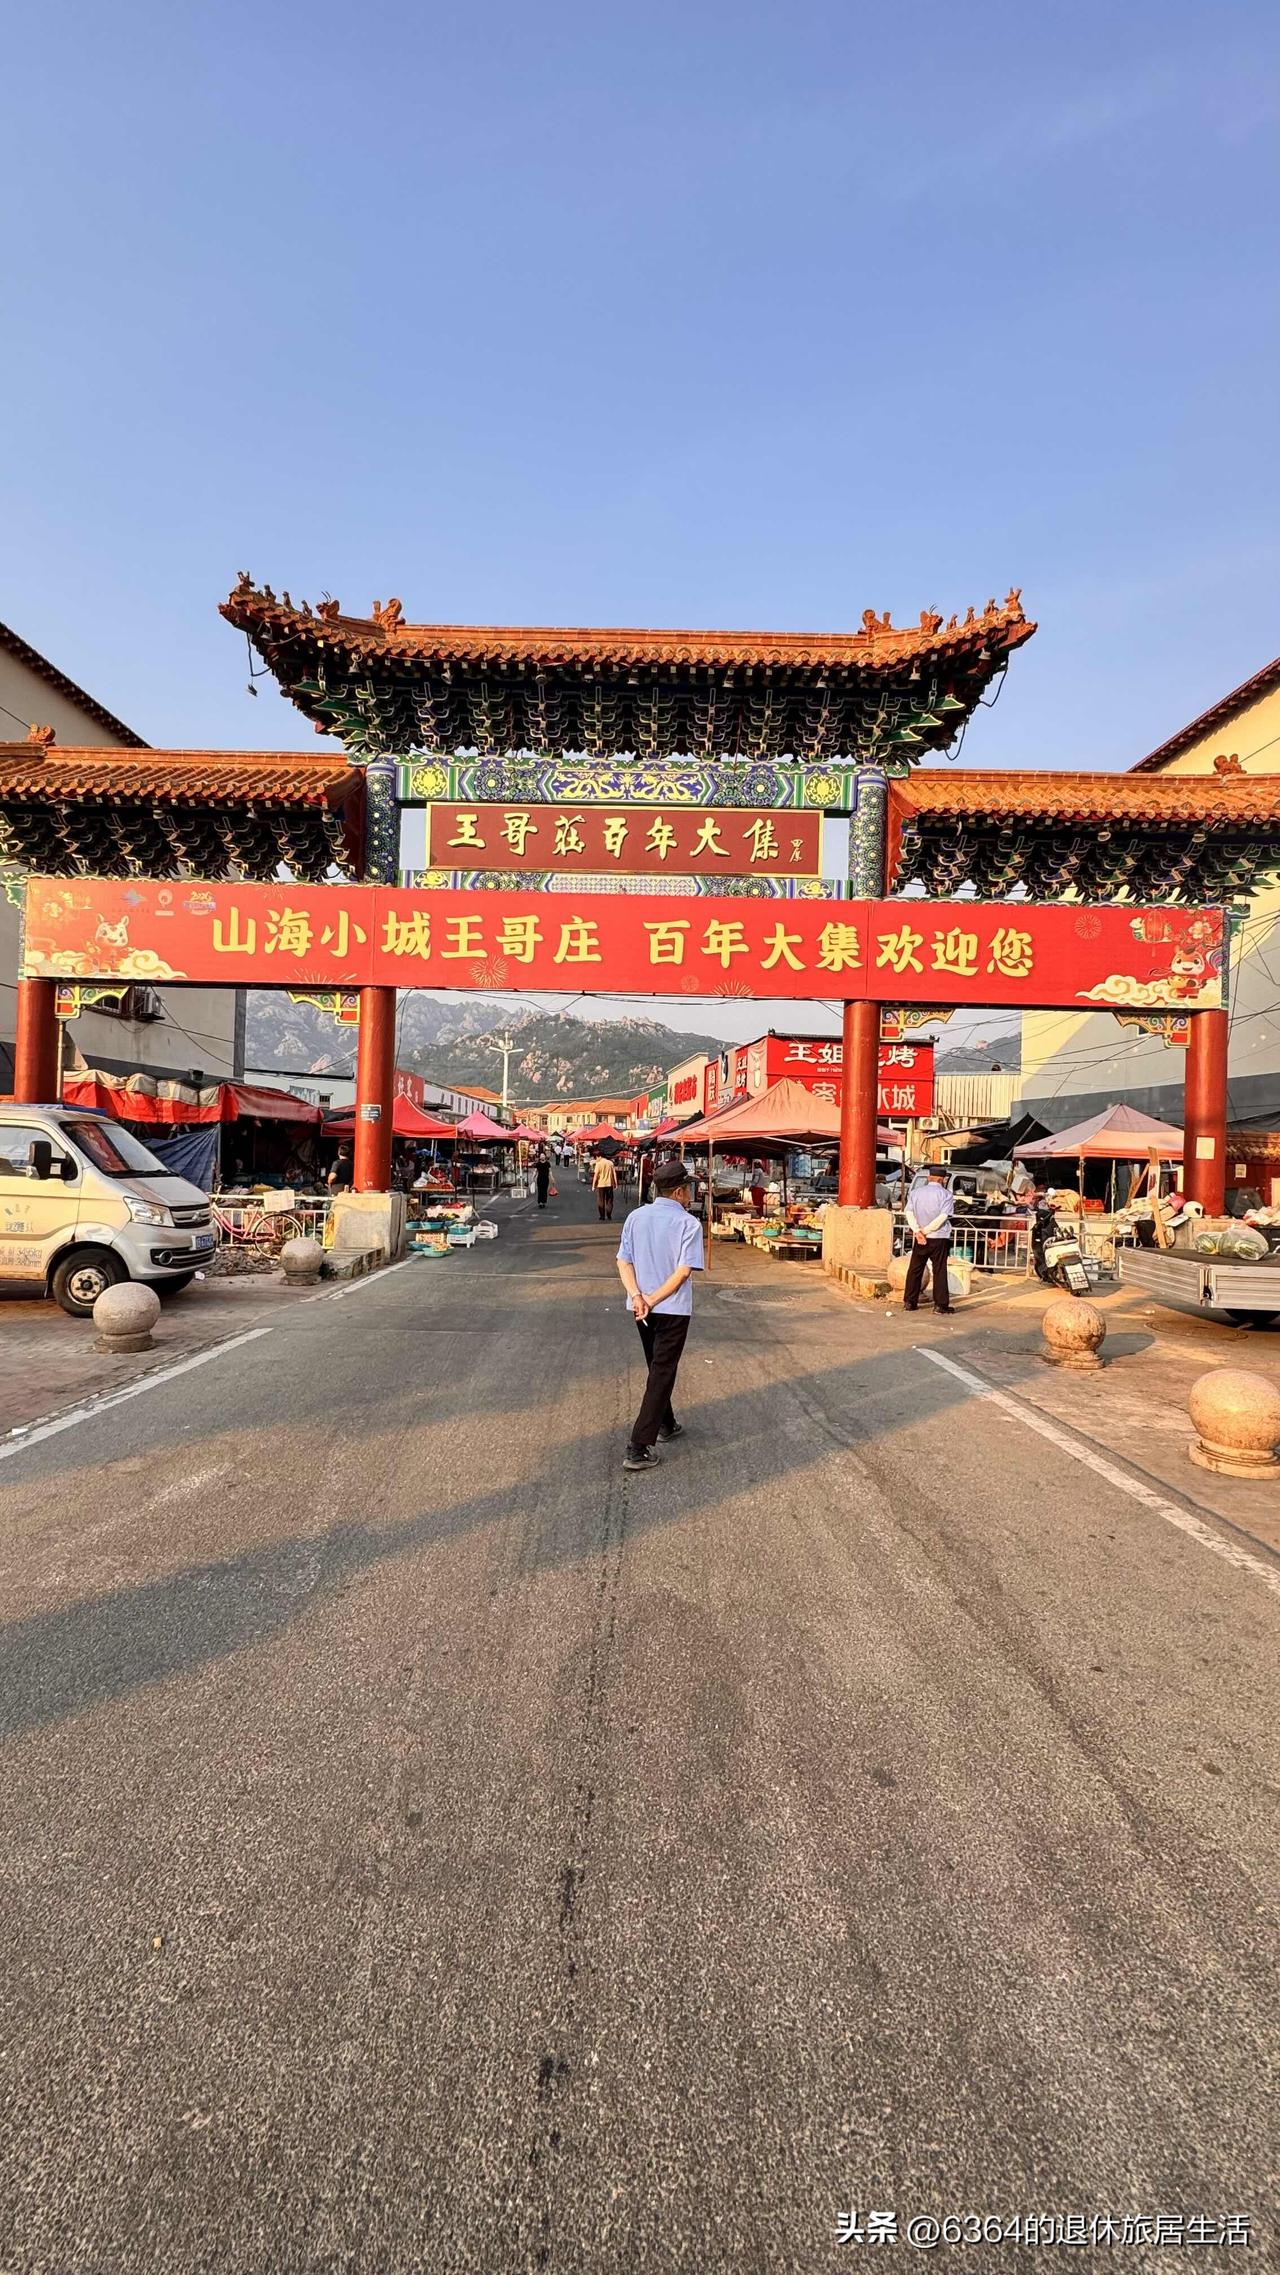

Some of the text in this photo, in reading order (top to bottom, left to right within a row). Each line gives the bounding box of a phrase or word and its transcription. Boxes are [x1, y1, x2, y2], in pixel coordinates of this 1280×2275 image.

[212, 906, 1034, 977] 山海小城王哥庄 百年大集欢迎您
